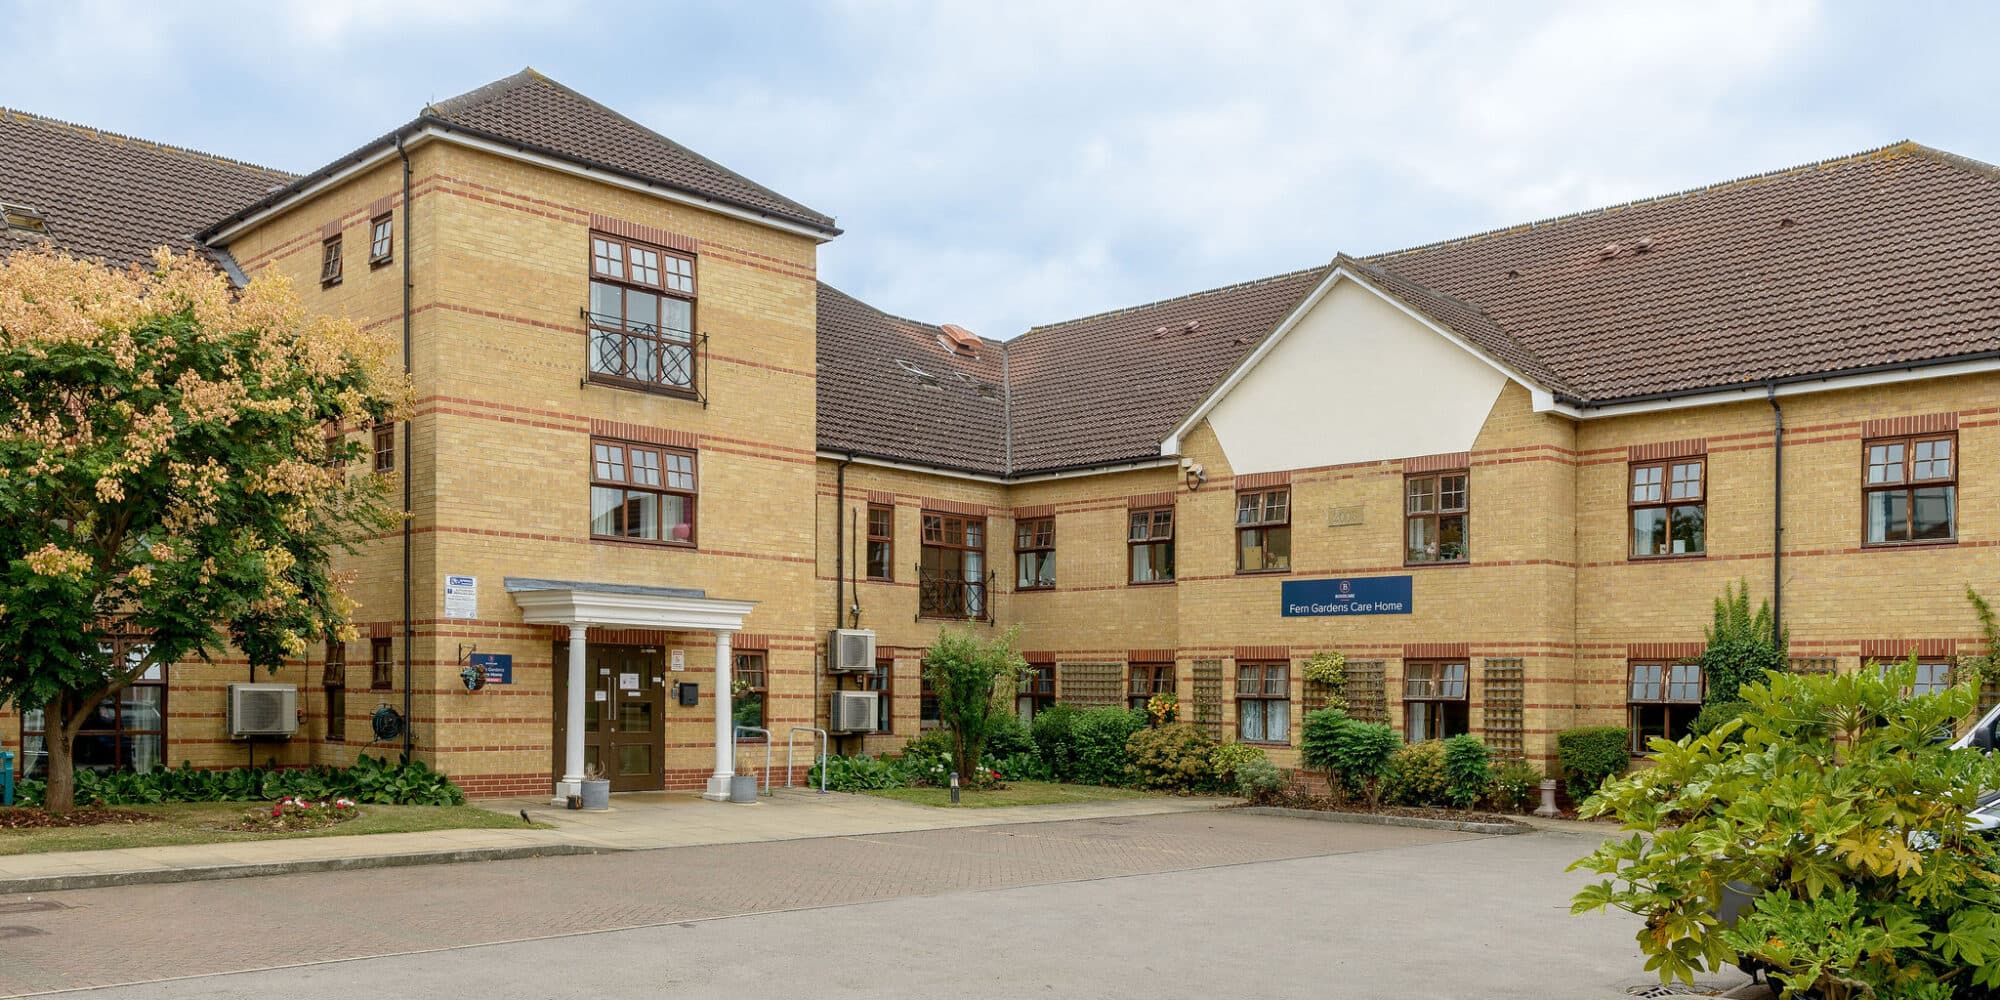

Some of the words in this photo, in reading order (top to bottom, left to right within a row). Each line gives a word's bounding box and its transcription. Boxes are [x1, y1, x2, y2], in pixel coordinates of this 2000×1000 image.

[1289, 604, 1309, 614] Fern
[1311, 602, 1348, 613] Gardens
[1350, 601, 1372, 612] Care
[1374, 601, 1403, 611] Home
